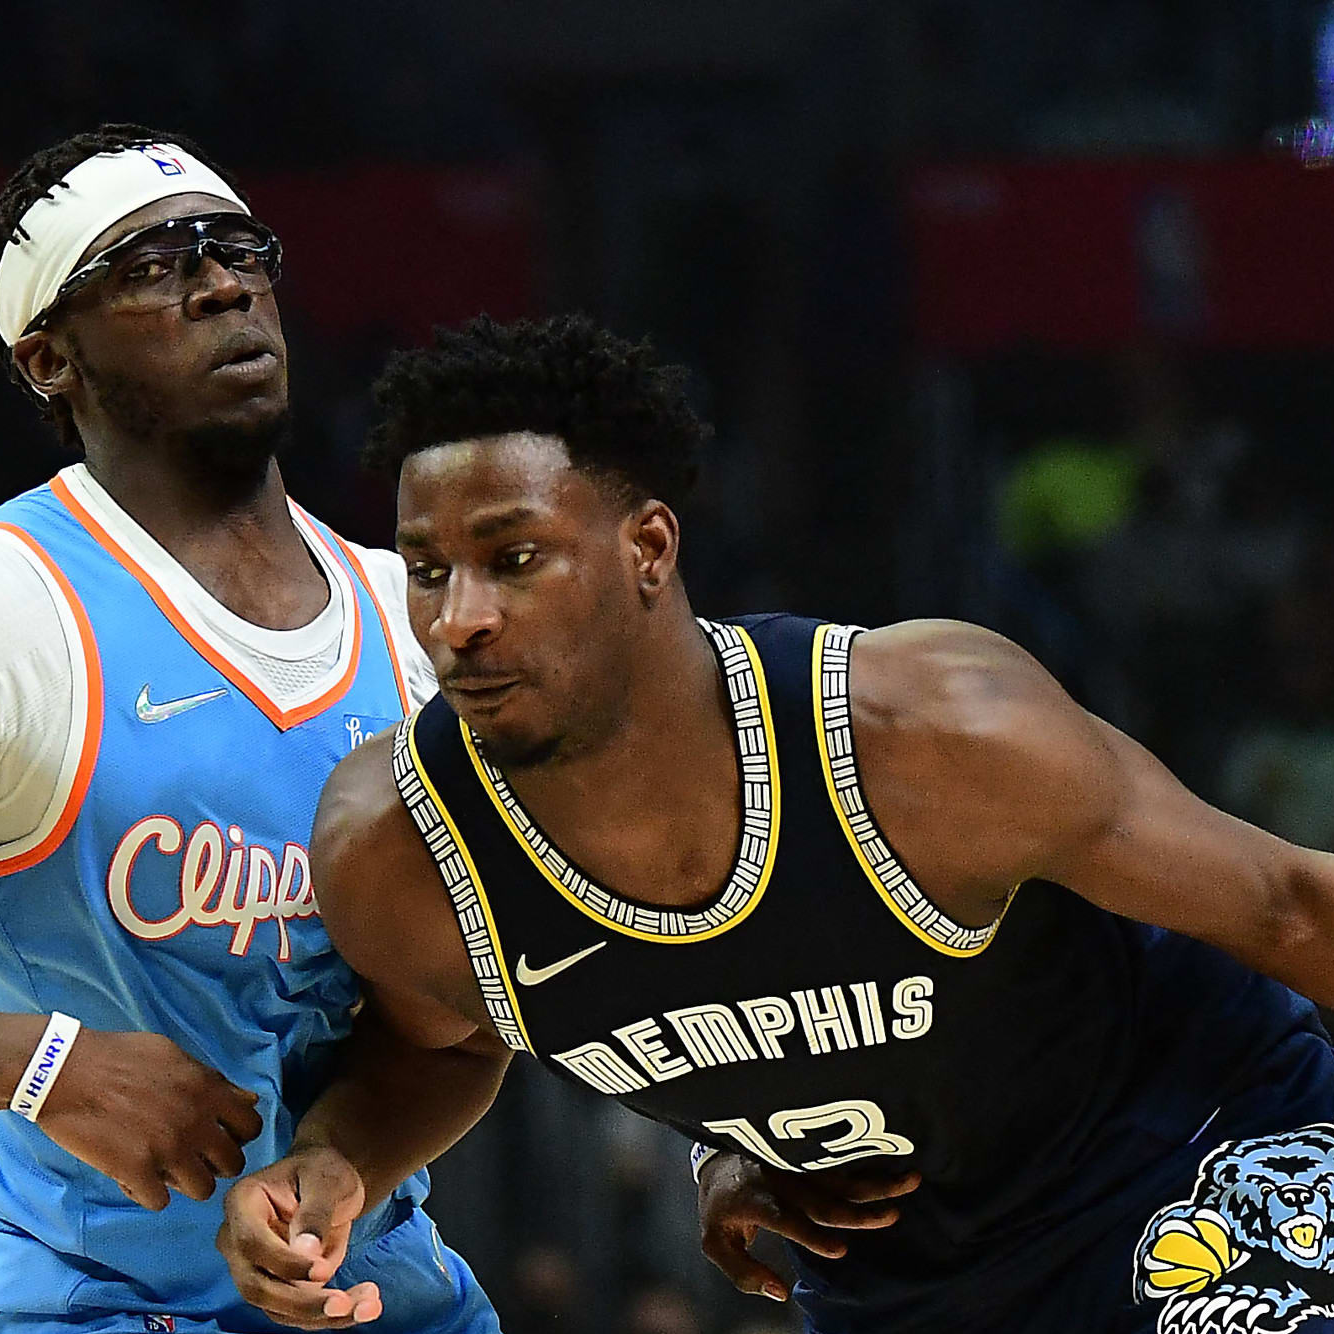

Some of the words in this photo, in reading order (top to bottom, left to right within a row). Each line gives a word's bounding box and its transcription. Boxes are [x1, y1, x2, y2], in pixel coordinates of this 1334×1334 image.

[105, 814, 321, 963] Clipp
[26, 1032, 66, 1098] HENRY
[551, 975, 934, 1095] MEMPHIS
[701, 1100, 915, 1173] 13
